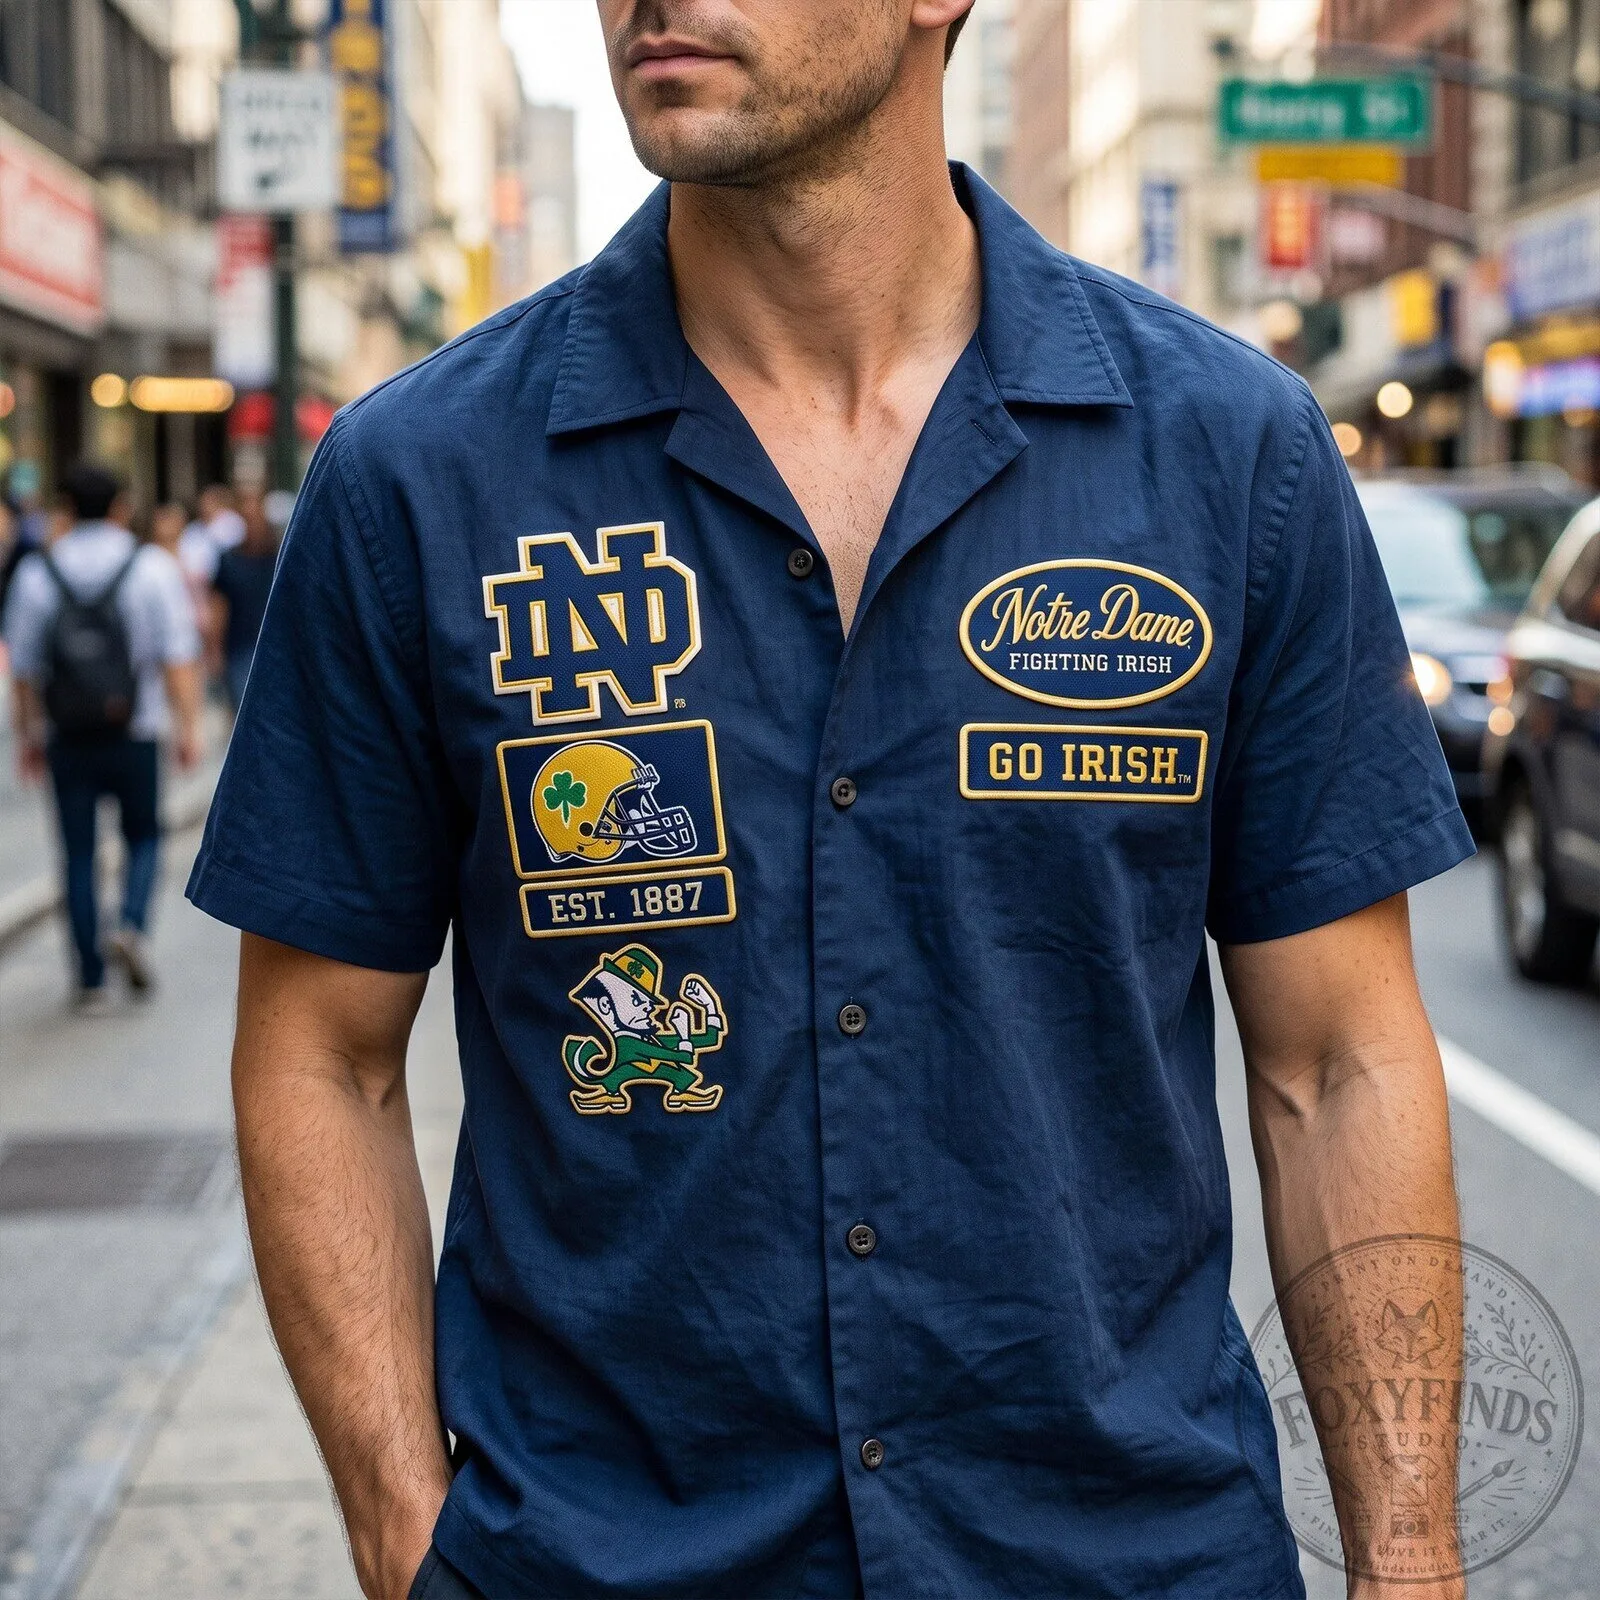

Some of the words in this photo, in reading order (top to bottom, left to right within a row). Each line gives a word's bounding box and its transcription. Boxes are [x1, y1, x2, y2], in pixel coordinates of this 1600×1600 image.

[980, 583, 1091, 652] Notre
[1091, 583, 1195, 647] Dame
[1009, 652, 1109, 672] FIGHTING
[1116, 654, 1172, 674] IRISH
[988, 742, 1043, 781] GO
[1061, 743, 1178, 784] IRISH
[548, 890, 616, 923] EST.
[629, 881, 703, 917] 1887
